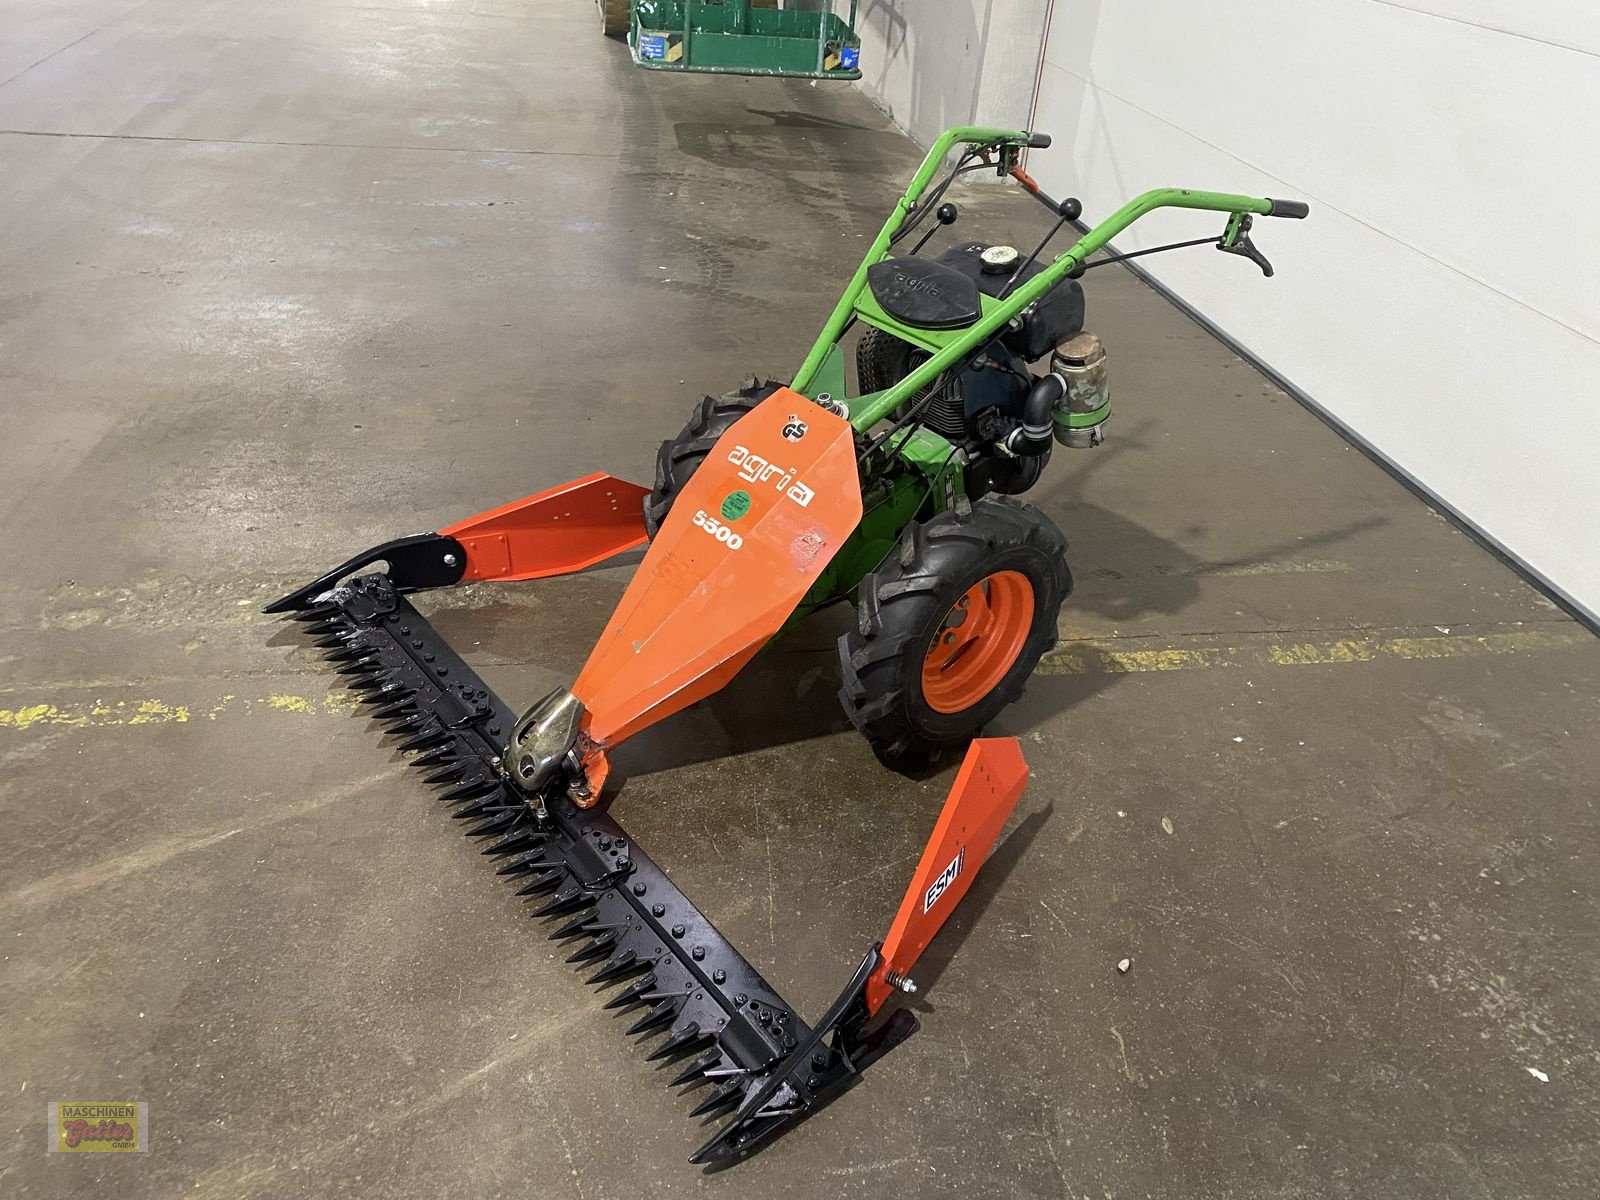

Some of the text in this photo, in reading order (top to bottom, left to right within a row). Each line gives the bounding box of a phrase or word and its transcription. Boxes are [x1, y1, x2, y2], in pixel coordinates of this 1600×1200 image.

[782, 423, 807, 439] GS
[727, 445, 816, 508] agria
[692, 509, 744, 550] 5500
[926, 859, 957, 910] ESM
